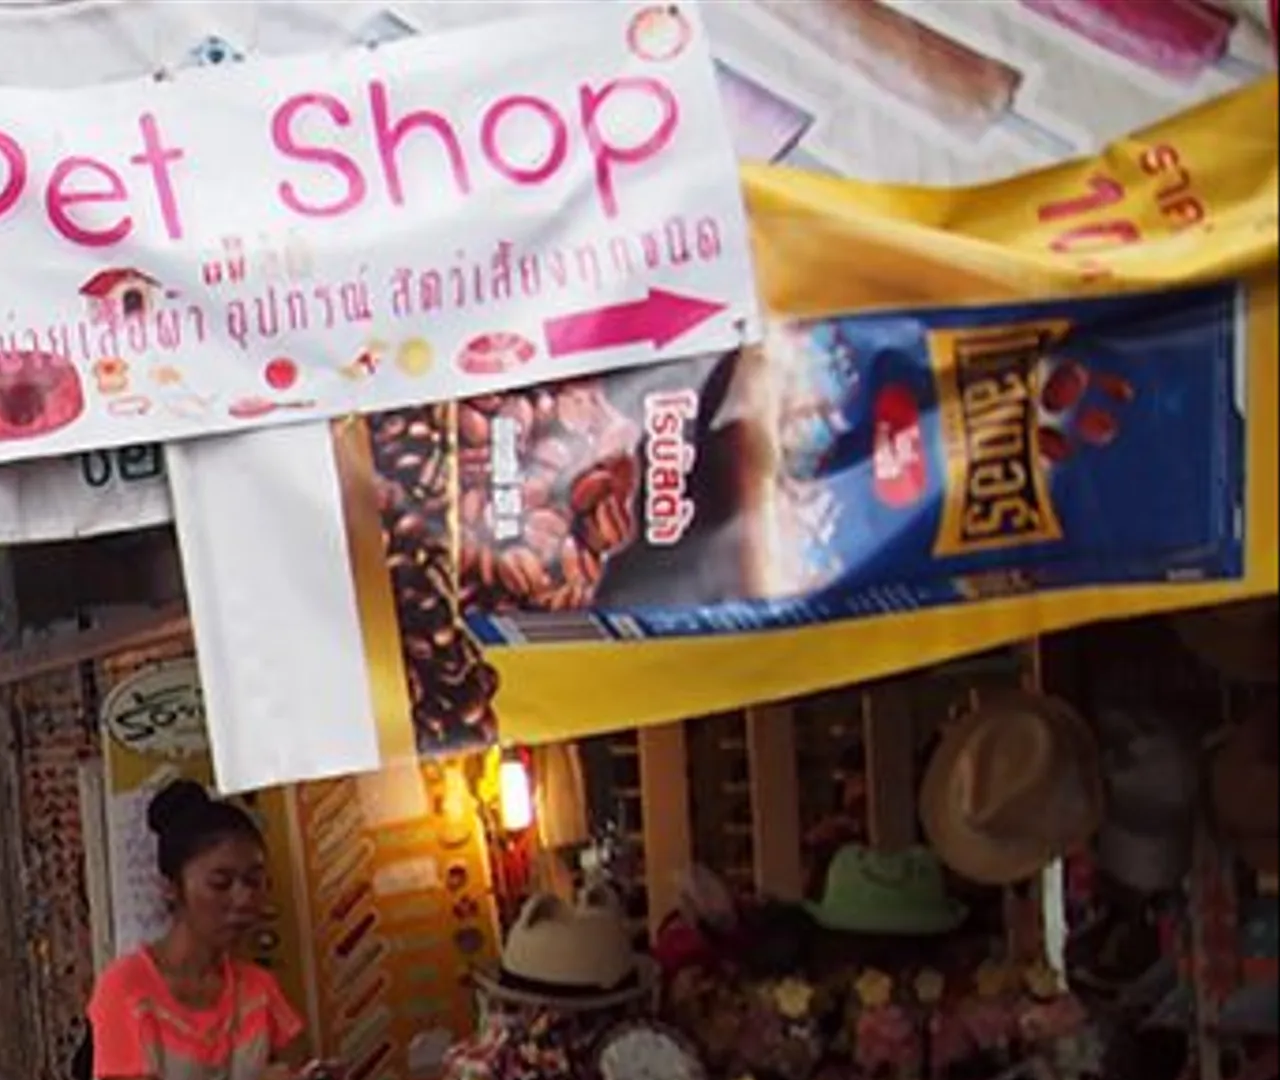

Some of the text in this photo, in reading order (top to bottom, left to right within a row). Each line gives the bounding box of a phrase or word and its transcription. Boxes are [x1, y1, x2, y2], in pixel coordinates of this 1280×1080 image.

[269, 74, 682, 218] Shop
[226, 263, 373, 351] อุปกรณ์
